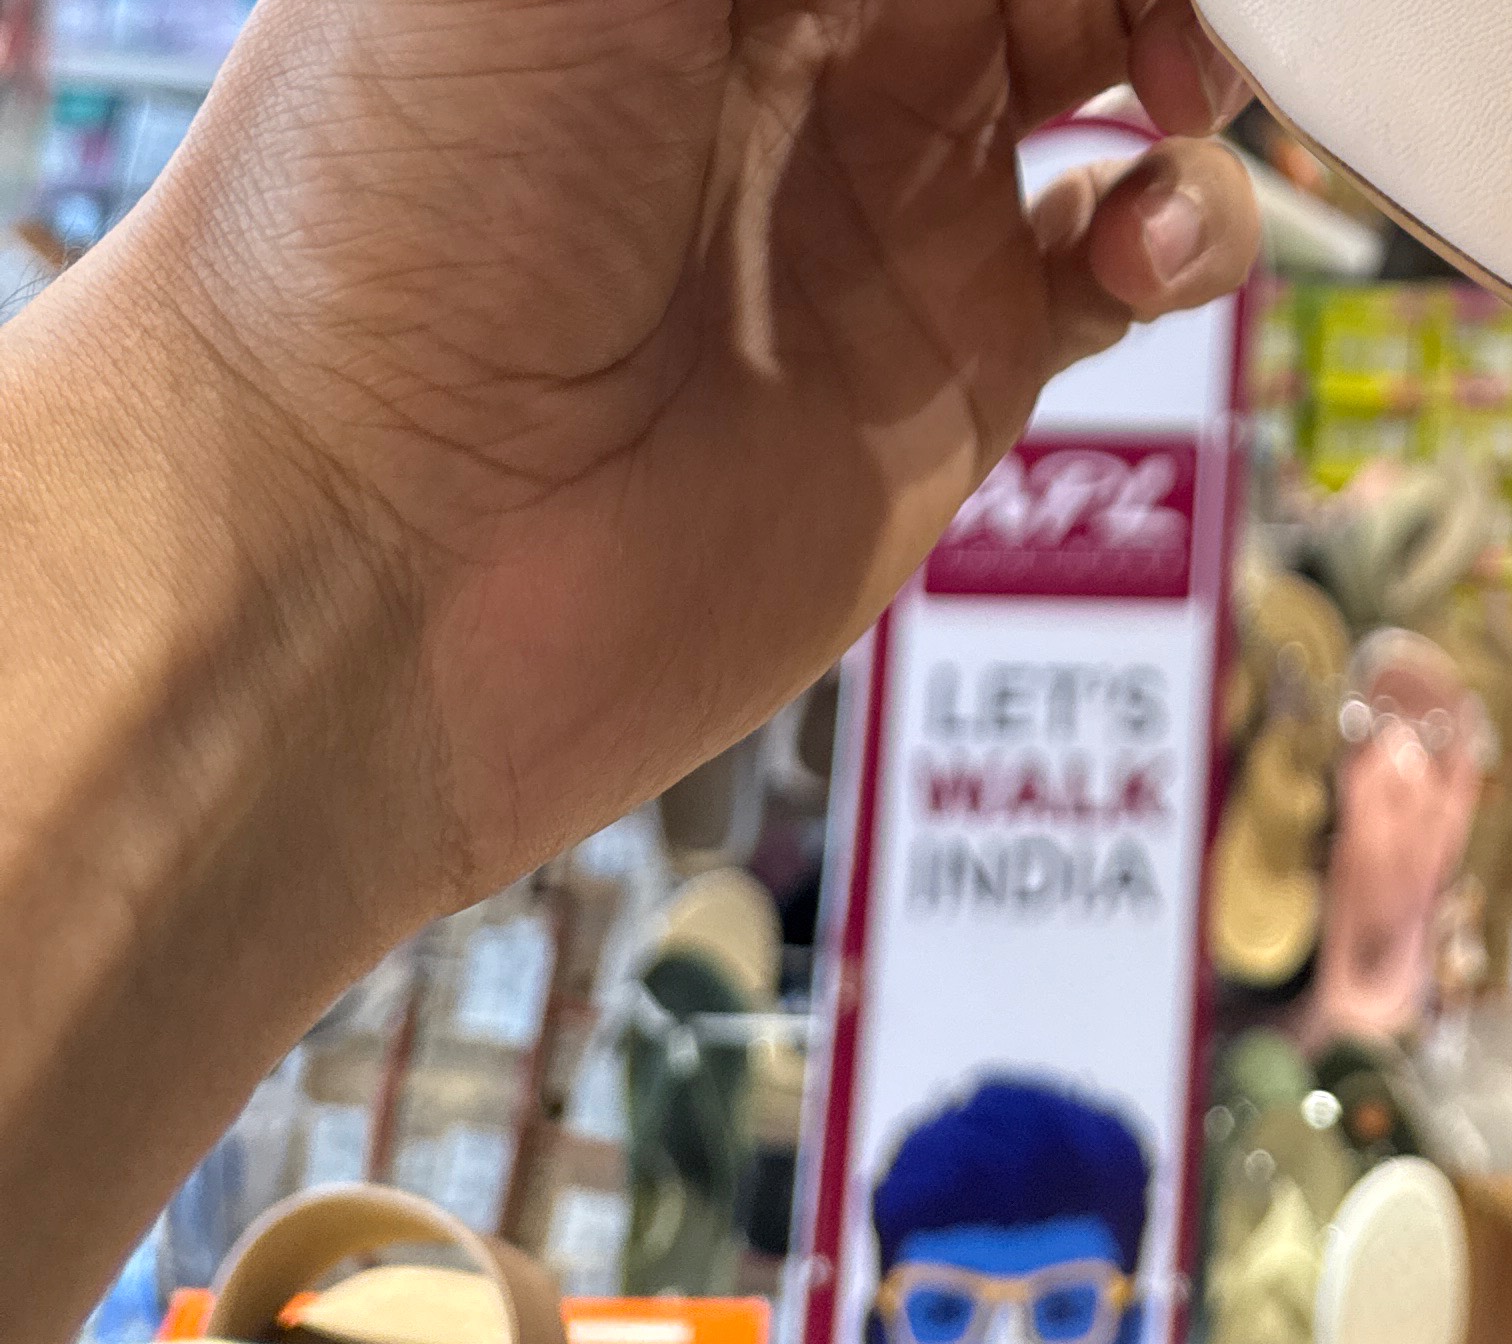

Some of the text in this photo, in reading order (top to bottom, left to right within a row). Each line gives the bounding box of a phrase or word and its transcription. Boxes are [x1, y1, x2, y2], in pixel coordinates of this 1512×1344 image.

[923, 662, 1169, 741] LET'S
[912, 746, 1176, 827] WALK
[906, 834, 1160, 916] INDIA
